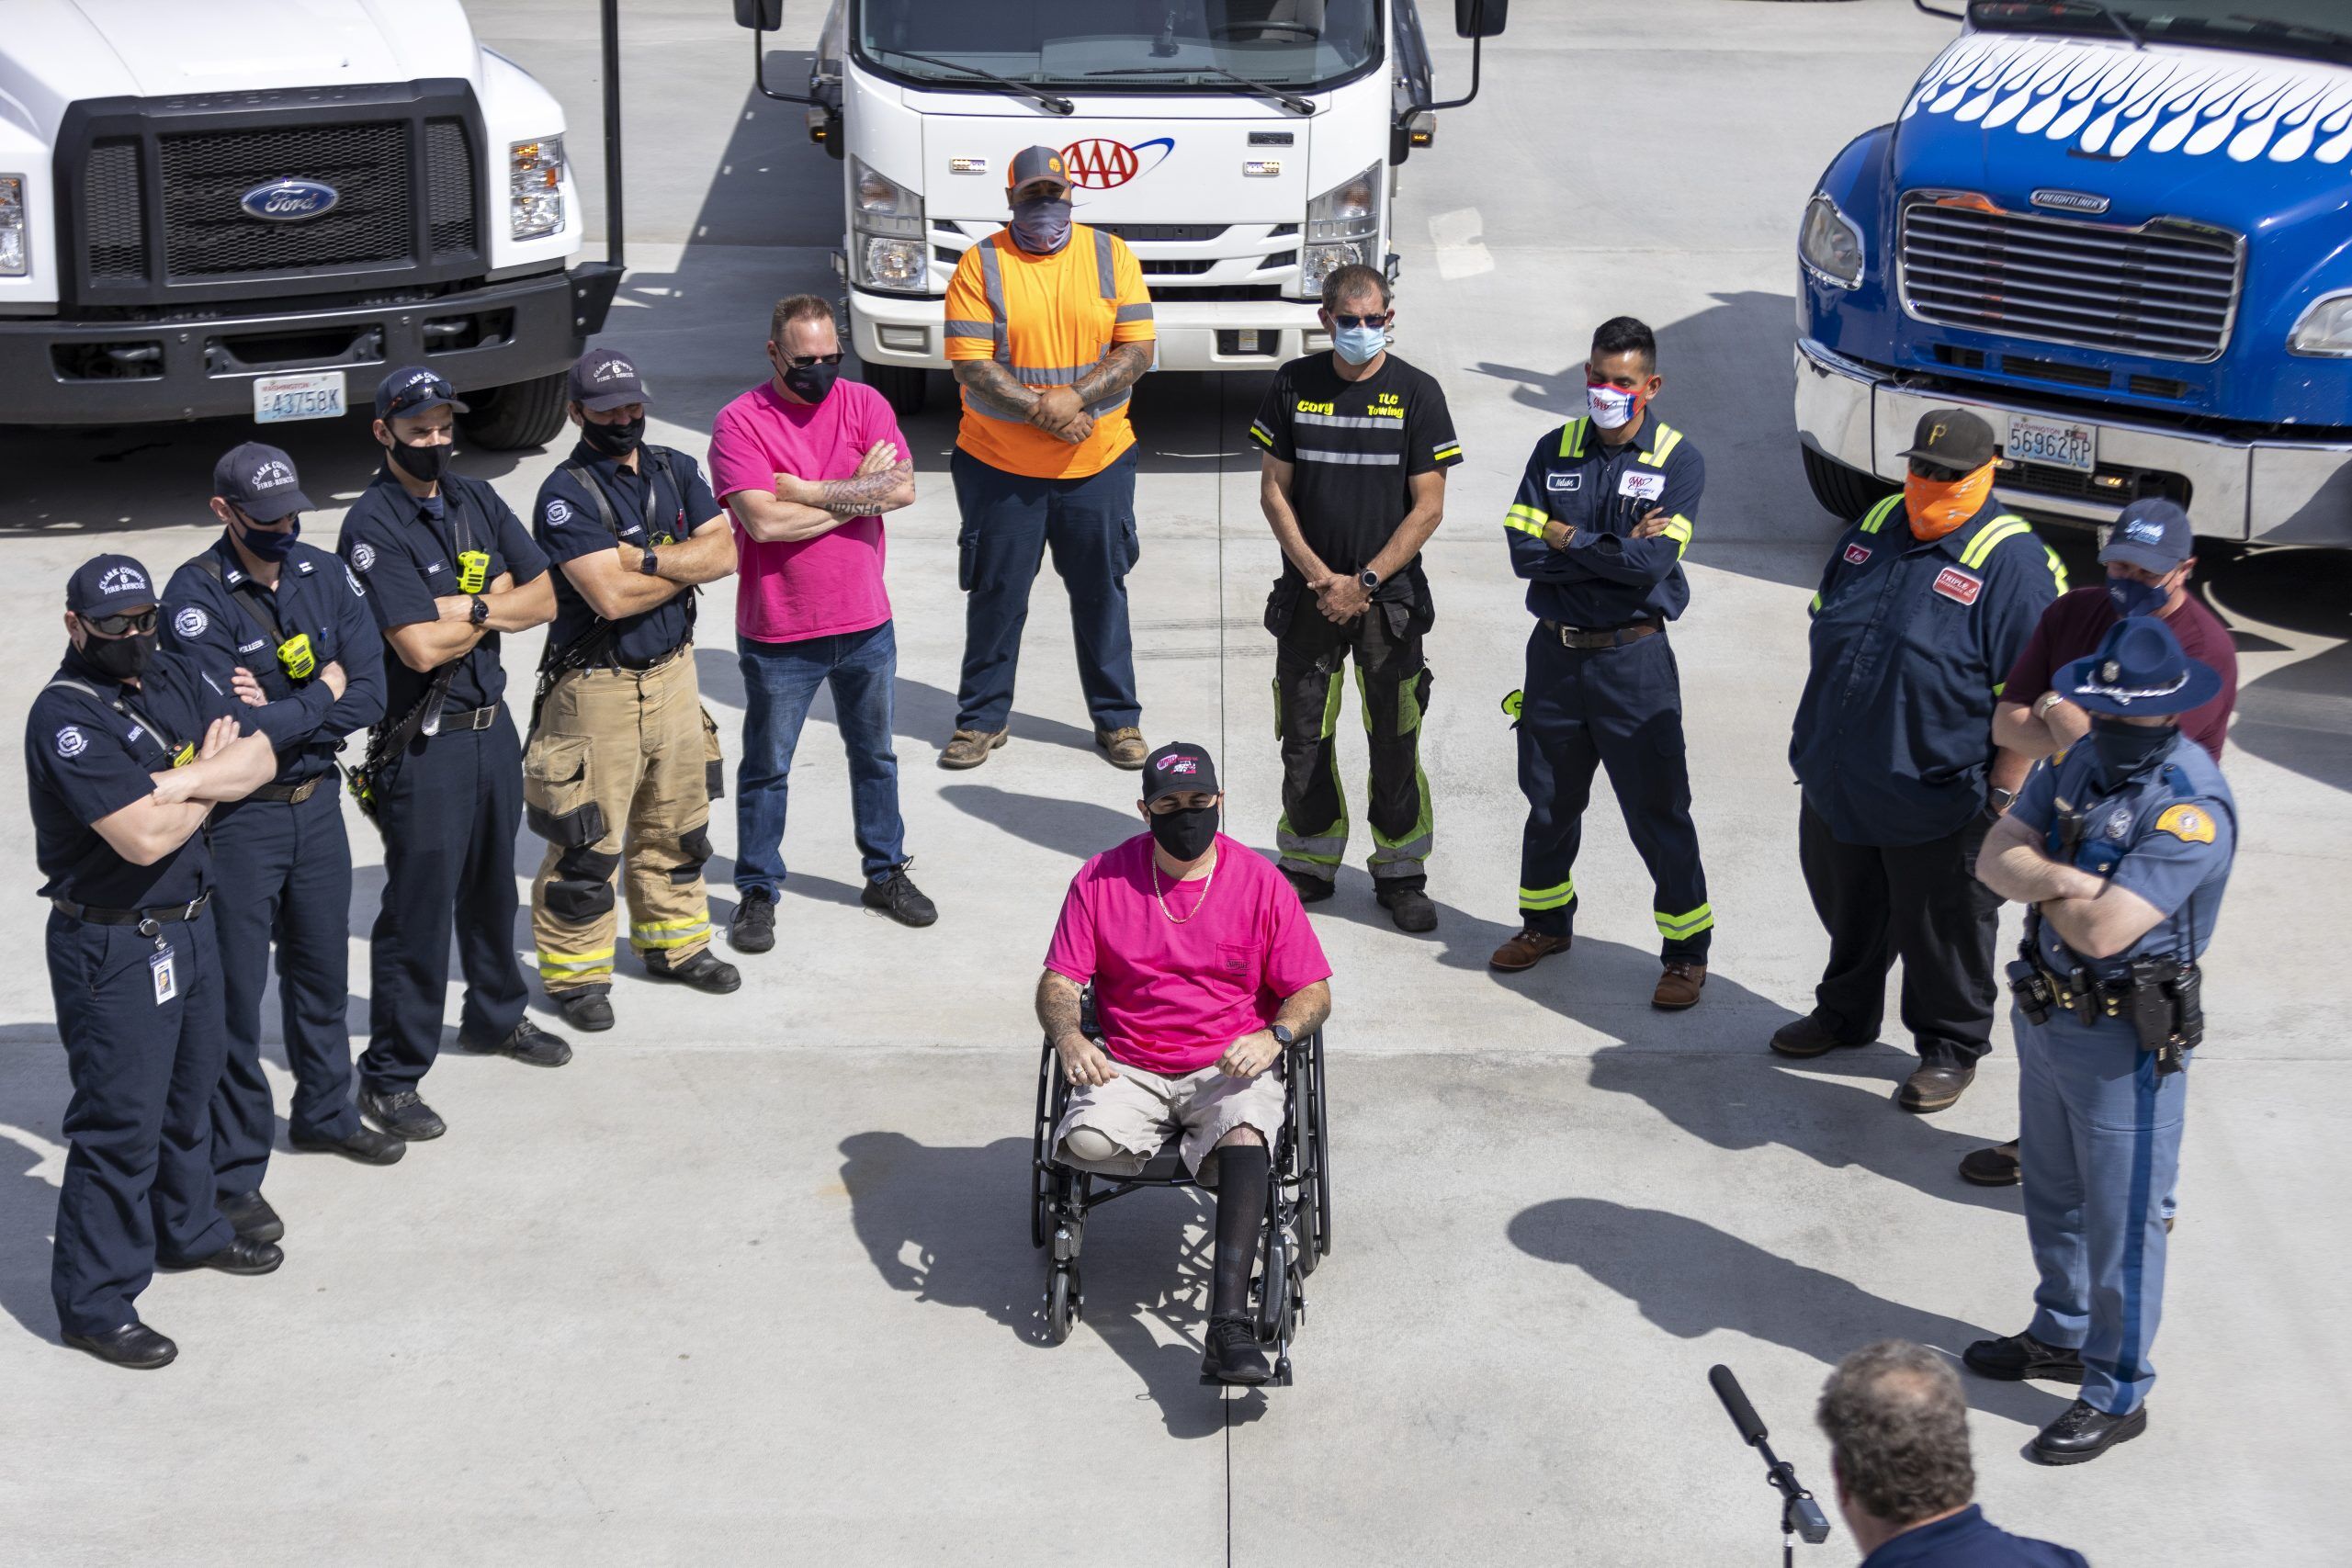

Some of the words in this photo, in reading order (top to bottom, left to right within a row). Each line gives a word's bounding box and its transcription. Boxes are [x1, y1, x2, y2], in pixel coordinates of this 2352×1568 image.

[1066, 138, 1131, 188] AAA
[265, 189, 319, 213] Ford
[2037, 192, 2100, 209] FREIGHTLINER
[612, 365, 621, 374] 6
[272, 389, 339, 414] 43758K
[1378, 392, 1399, 404] TLC
[1296, 399, 1335, 416] Cory
[1367, 404, 1405, 419] Towing
[1928, 424, 1947, 446] P
[2013, 423, 2060, 434] WASHINGTON
[2010, 428, 2091, 461] 56962RP
[252, 462, 272, 485] CLARK
[273, 468, 281, 479] 6
[834, 502, 874, 514] IRISH
[98, 568, 119, 589] CLARK
[119, 566, 146, 583] COUNTY
[120, 574, 129, 584] 6
[1941, 573, 1969, 590] TRIPLE
